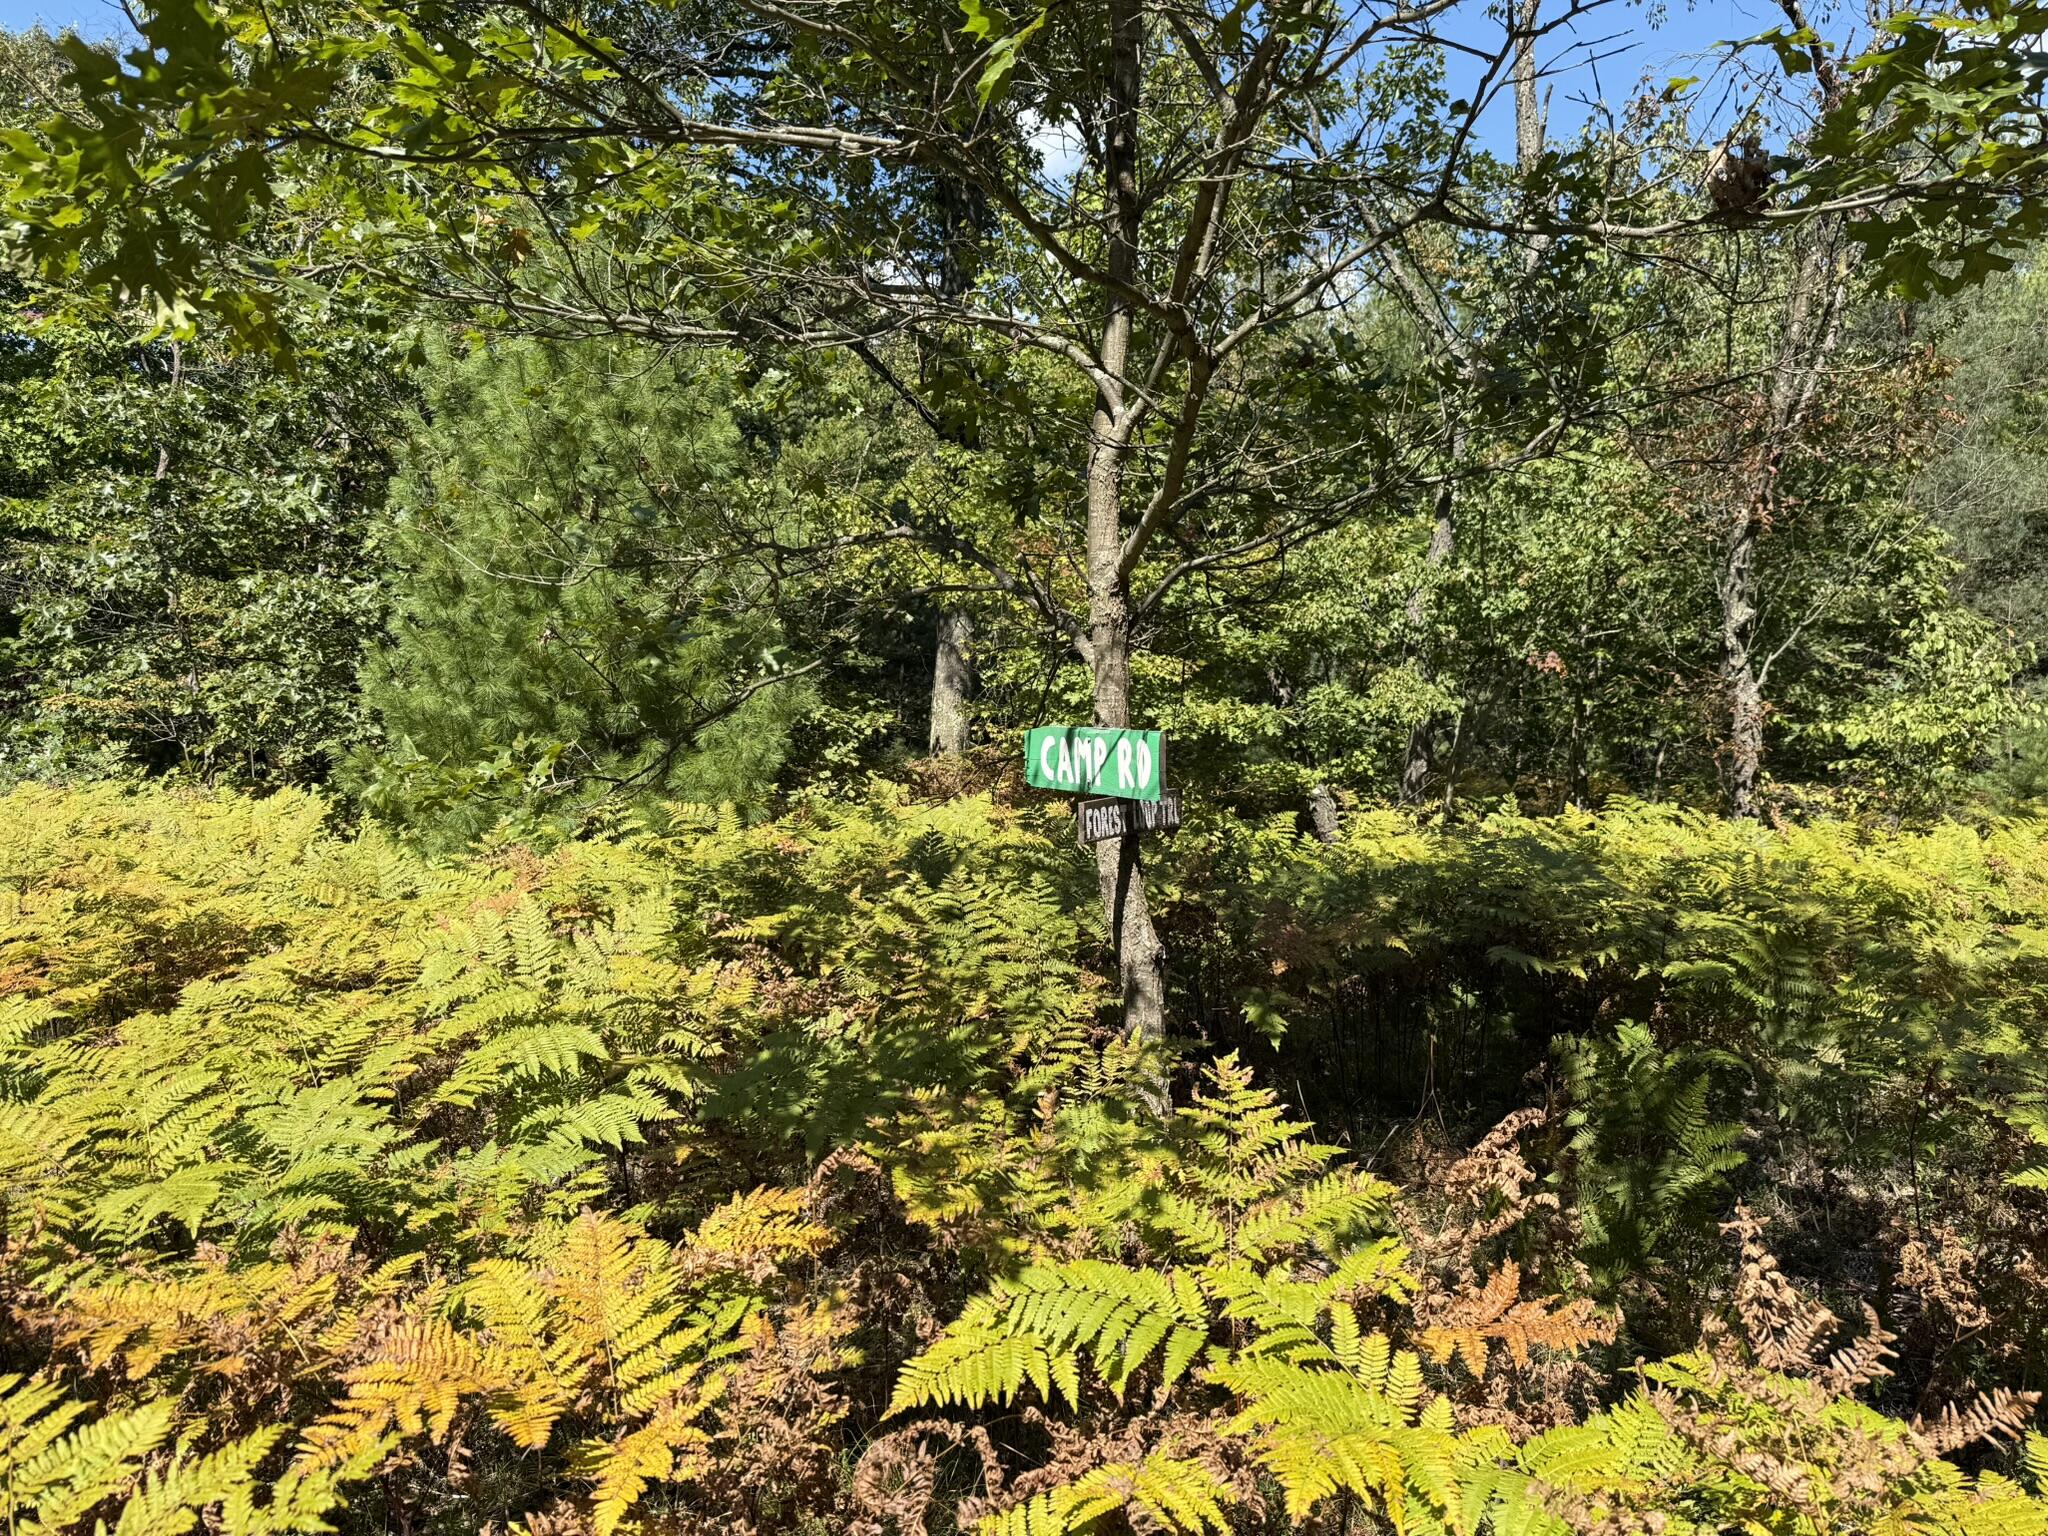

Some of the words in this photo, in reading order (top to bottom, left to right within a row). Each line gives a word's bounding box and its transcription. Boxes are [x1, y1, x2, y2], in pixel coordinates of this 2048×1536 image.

[1040, 735, 1107, 787] CAMP
[1117, 738, 1152, 790] RD
[1085, 805, 1127, 840] FOREST
